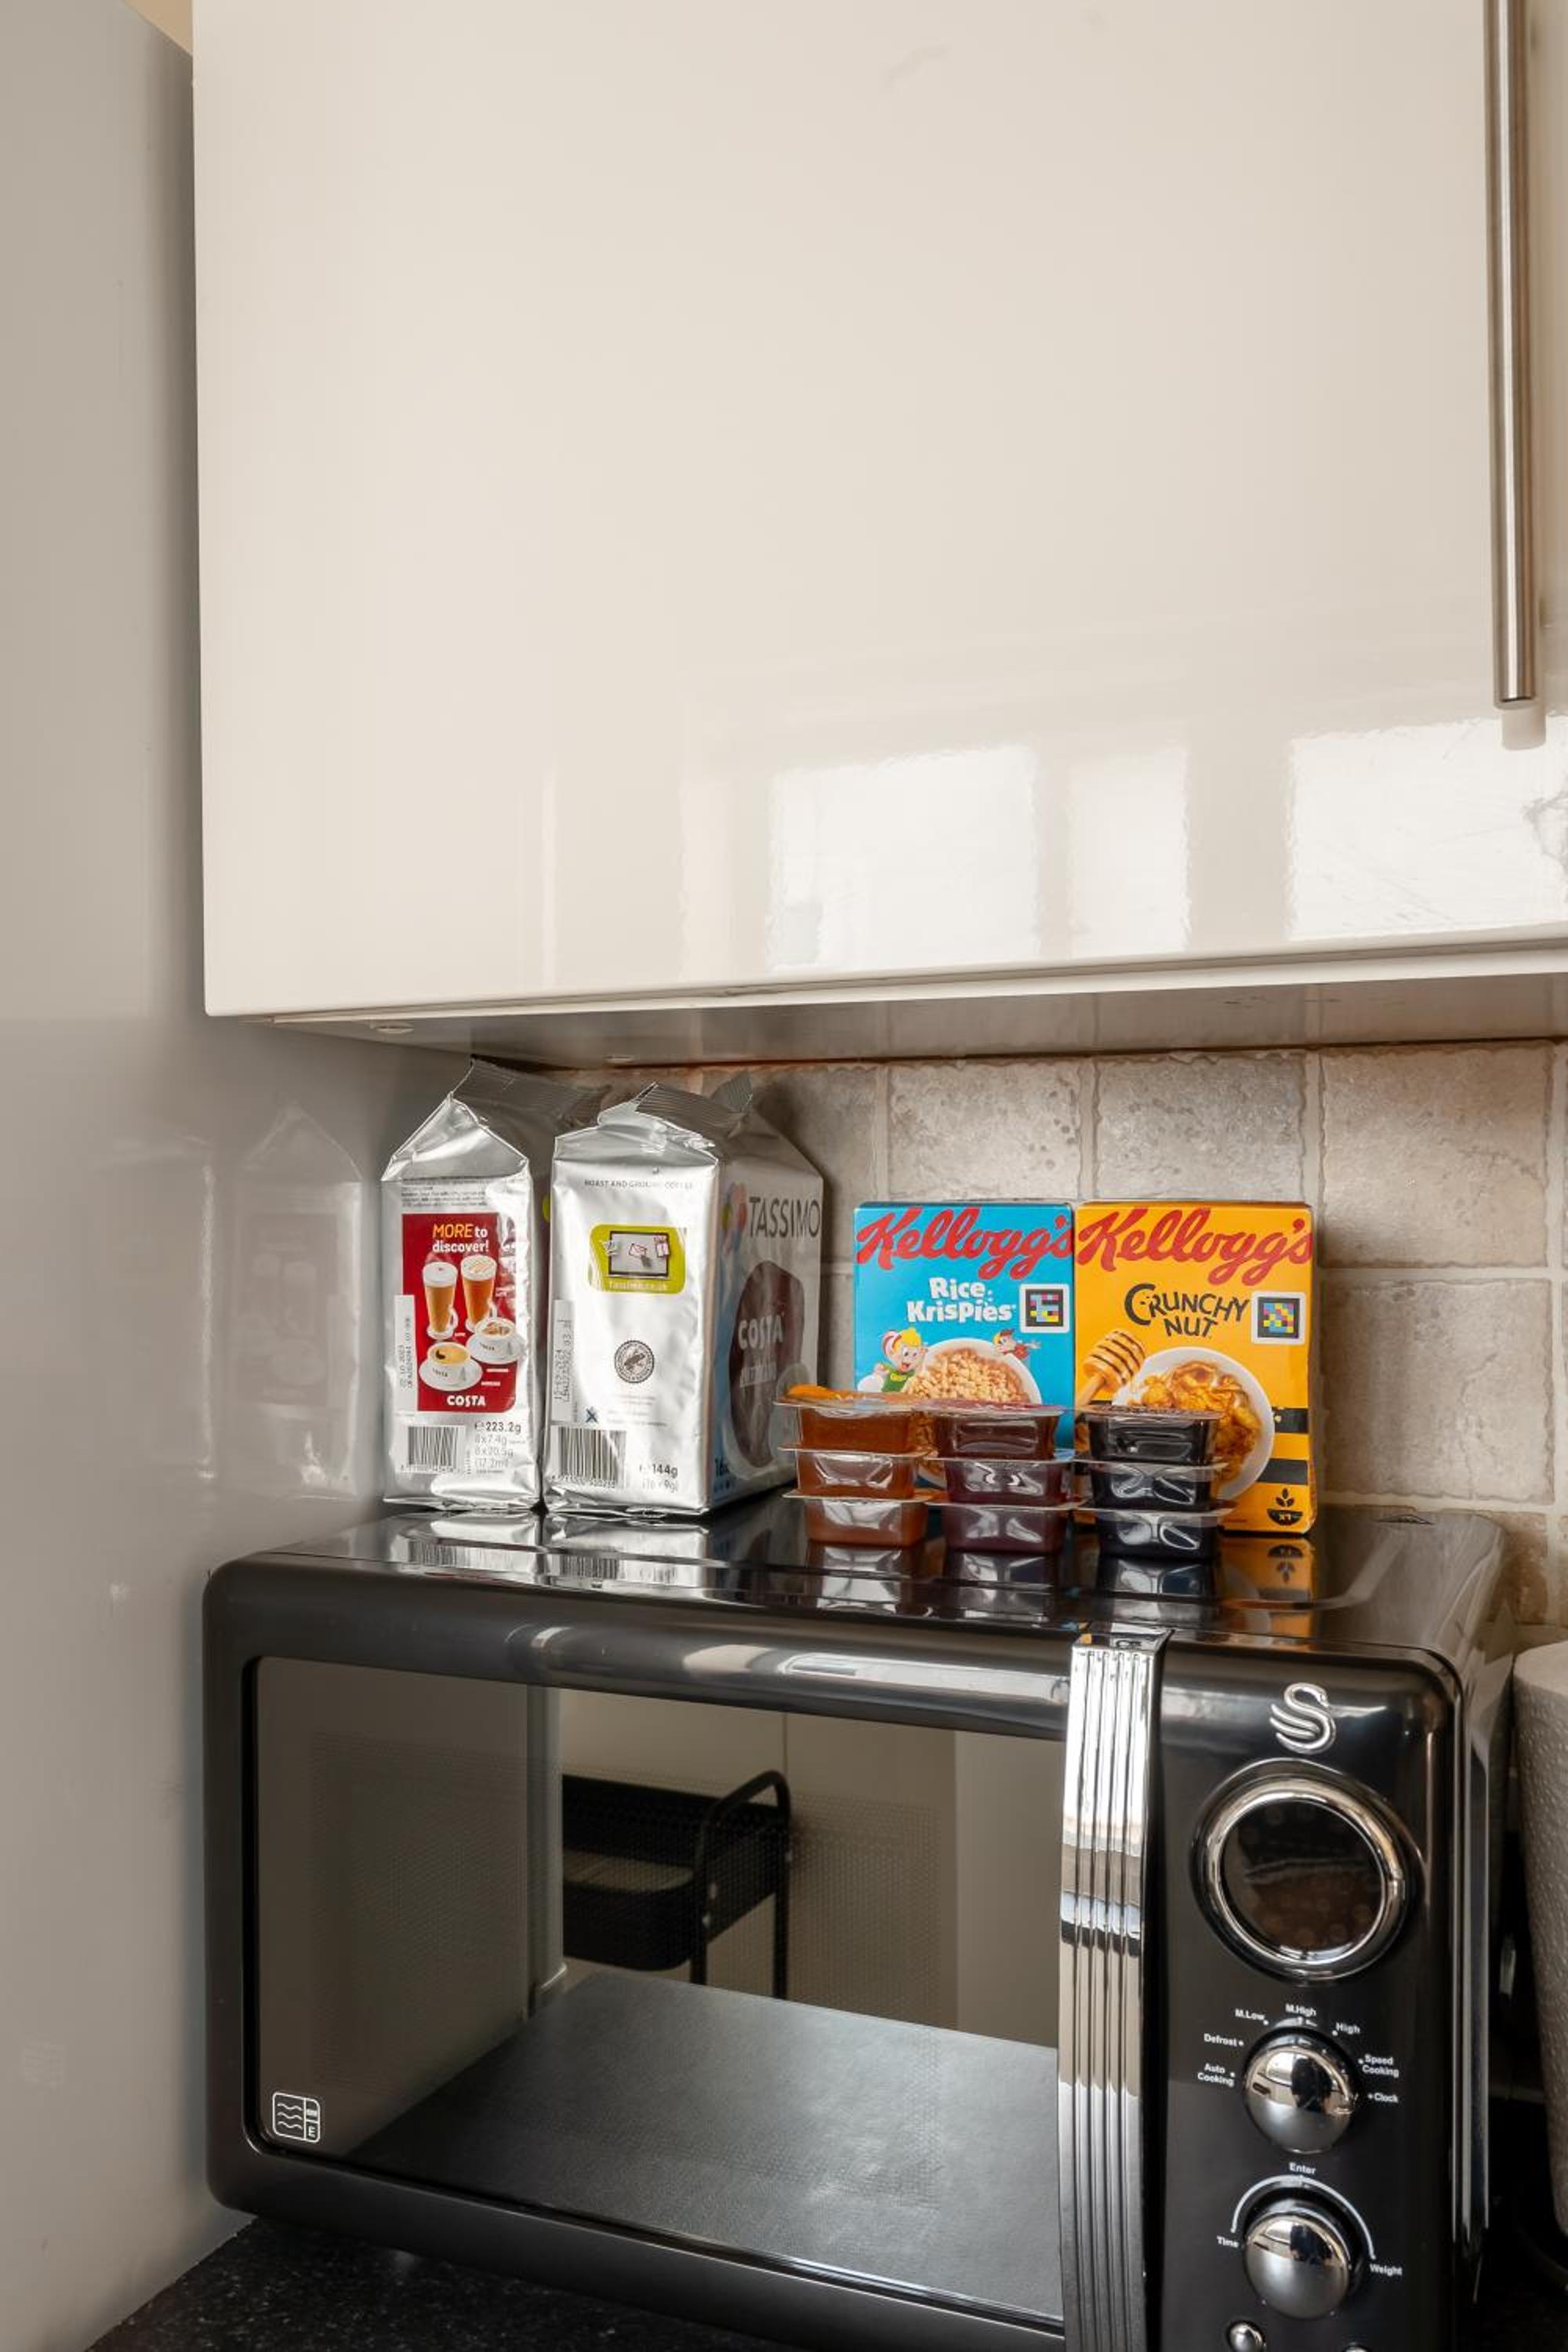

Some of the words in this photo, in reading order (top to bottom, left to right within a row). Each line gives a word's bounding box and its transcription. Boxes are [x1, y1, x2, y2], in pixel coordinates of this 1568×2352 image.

[749, 1196, 822, 1239] TASSIMO
[433, 1224, 474, 1238] MORE
[474, 1226, 488, 1238] to
[432, 1240, 489, 1253] discover!
[855, 1207, 1073, 1279] Kellogg's
[1075, 1207, 1314, 1286] Kellogg's
[928, 1276, 985, 1300] Rice
[906, 1299, 1014, 1323] Krispies
[1123, 1283, 1250, 1326] CRUNCHY
[738, 1316, 784, 1350] COSTA
[1163, 1316, 1218, 1339] NUT
[446, 1395, 486, 1407] COSTA
[485, 1421, 522, 1434] 223.2g
[652, 1463, 678, 1479] 144g
[1235, 2009, 1265, 2020] M.Low
[1285, 2004, 1316, 2017] M.High
[1336, 2022, 1360, 2034] High
[1203, 2033, 1238, 2048] Defrost
[1364, 2053, 1394, 2066] Speed
[1203, 2063, 1225, 2074] Auto
[1362, 2064, 1399, 2078] Cooking
[1197, 2072, 1234, 2087] Cooking
[1374, 2092, 1399, 2103] Clock
[1289, 2162, 1317, 2175] Enter
[1216, 2236, 1240, 2249] Time
[1370, 2263, 1403, 2277] Weight
